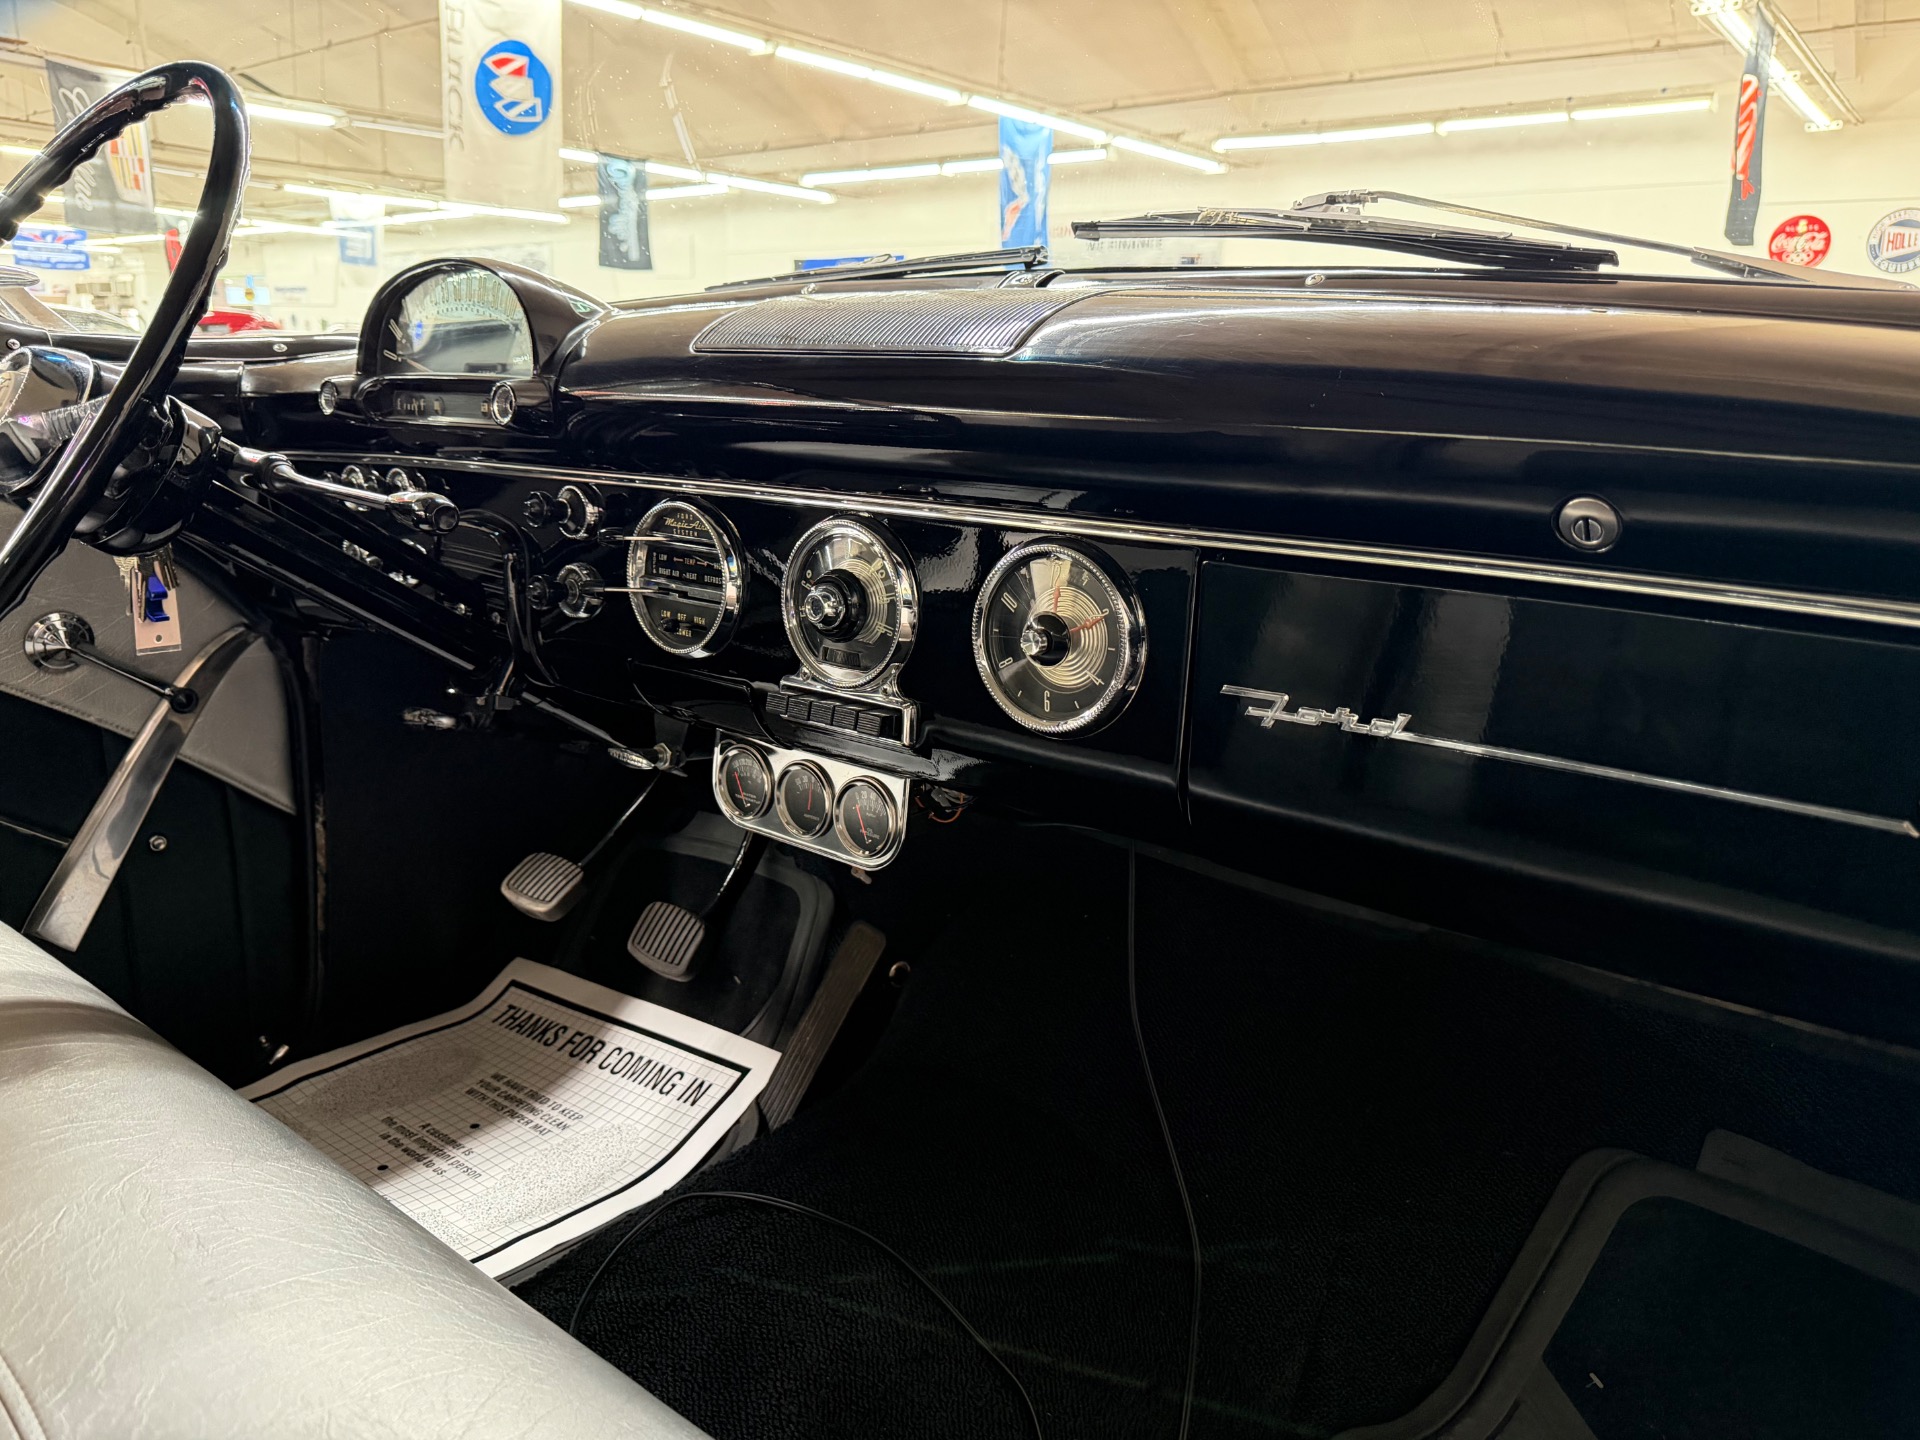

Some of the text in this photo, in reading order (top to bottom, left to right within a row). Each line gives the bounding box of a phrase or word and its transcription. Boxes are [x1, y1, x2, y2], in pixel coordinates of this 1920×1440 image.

[704, 575, 722, 585] DEFROS
[1001, 592, 1017, 612] 10
[999, 657, 1013, 668] 8
[1085, 670, 1104, 685] 4
[1044, 690, 1051, 712] 6
[492, 1004, 713, 1107] THANKS FOR COMING IN
[486, 1099, 508, 1112] THIS
[502, 1108, 533, 1126] PAPER
[529, 1123, 553, 1136] MAT
[496, 1090, 543, 1116] CARPETING
[540, 1113, 571, 1131] CLEAN
[524, 1089, 551, 1105] TRIED
[547, 1101, 562, 1111] TO
[560, 1107, 584, 1120] KEEP
[425, 1127, 466, 1151] customer
[461, 1148, 474, 1156] is
[401, 1146, 430, 1162] world
[422, 1160, 436, 1168] to
[432, 1166, 447, 1178] us.
[413, 1136, 456, 1162] important
[448, 1159, 482, 1180] person
